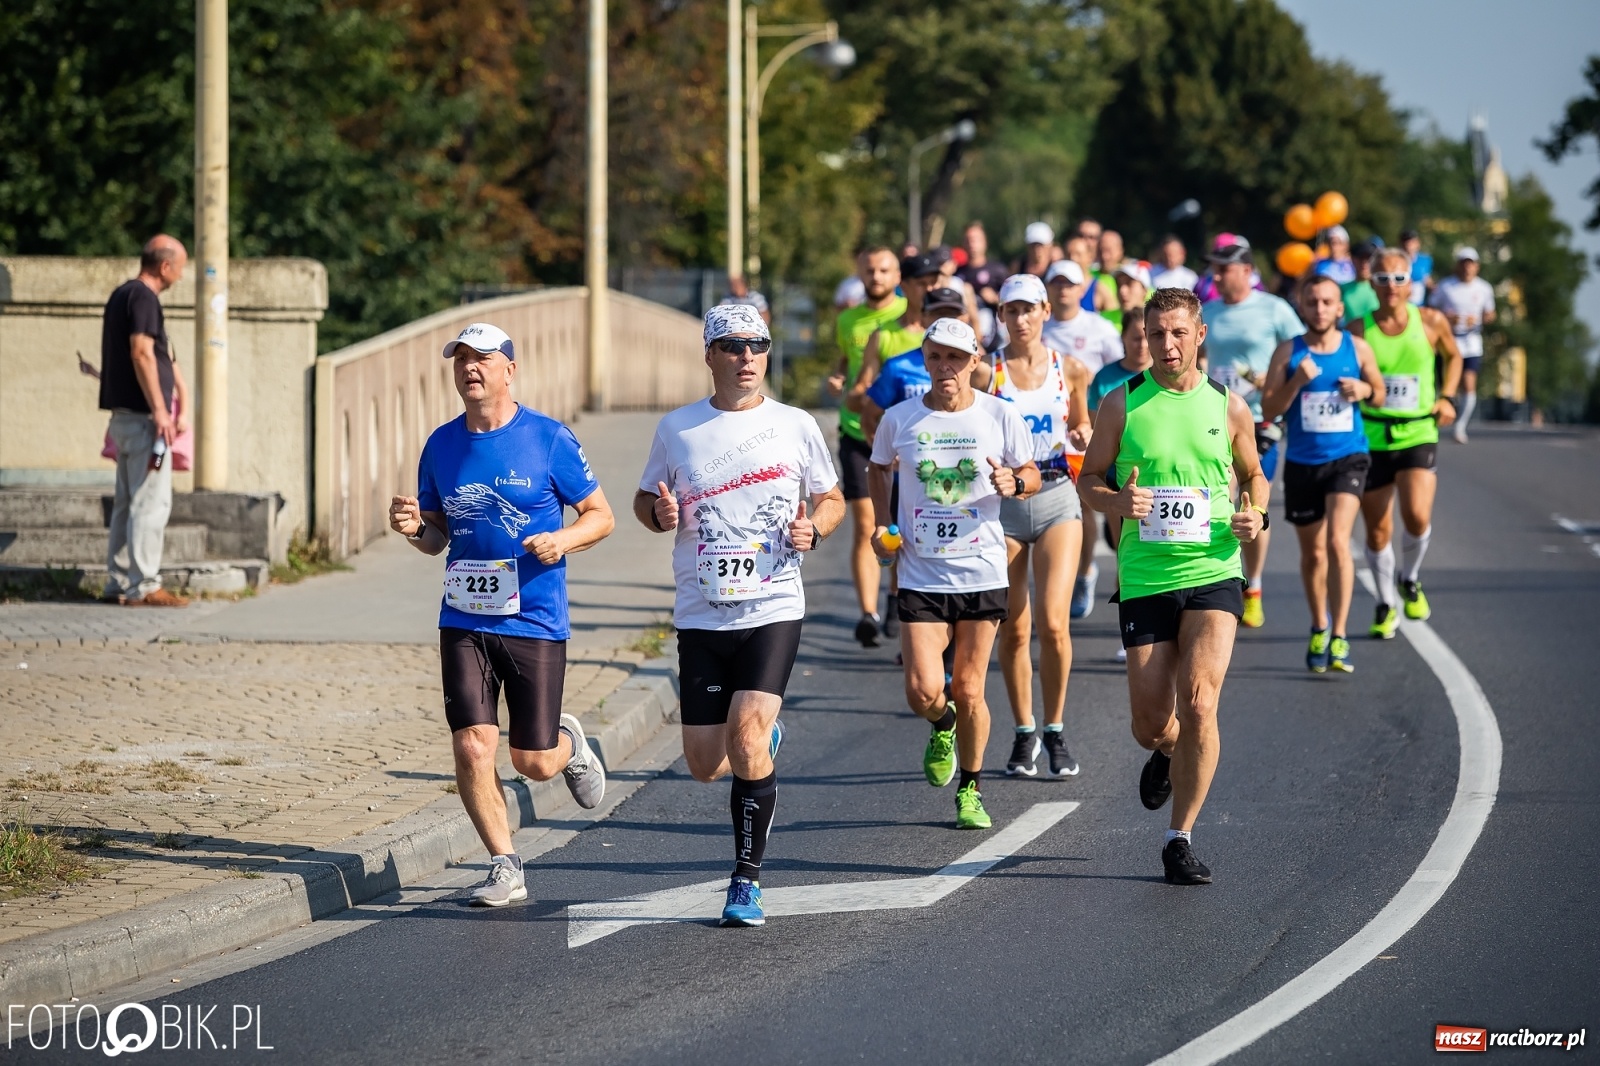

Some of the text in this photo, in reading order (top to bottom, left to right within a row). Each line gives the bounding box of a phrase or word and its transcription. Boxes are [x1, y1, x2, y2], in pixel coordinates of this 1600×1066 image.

[1207, 428, 1220, 436] 4F
[687, 428, 779, 484] KS GRYF KIETRZ
[1159, 501, 1195, 519] 360
[936, 522, 958, 538] 82
[717, 558, 755, 578] 379
[465, 575, 499, 594] 223
